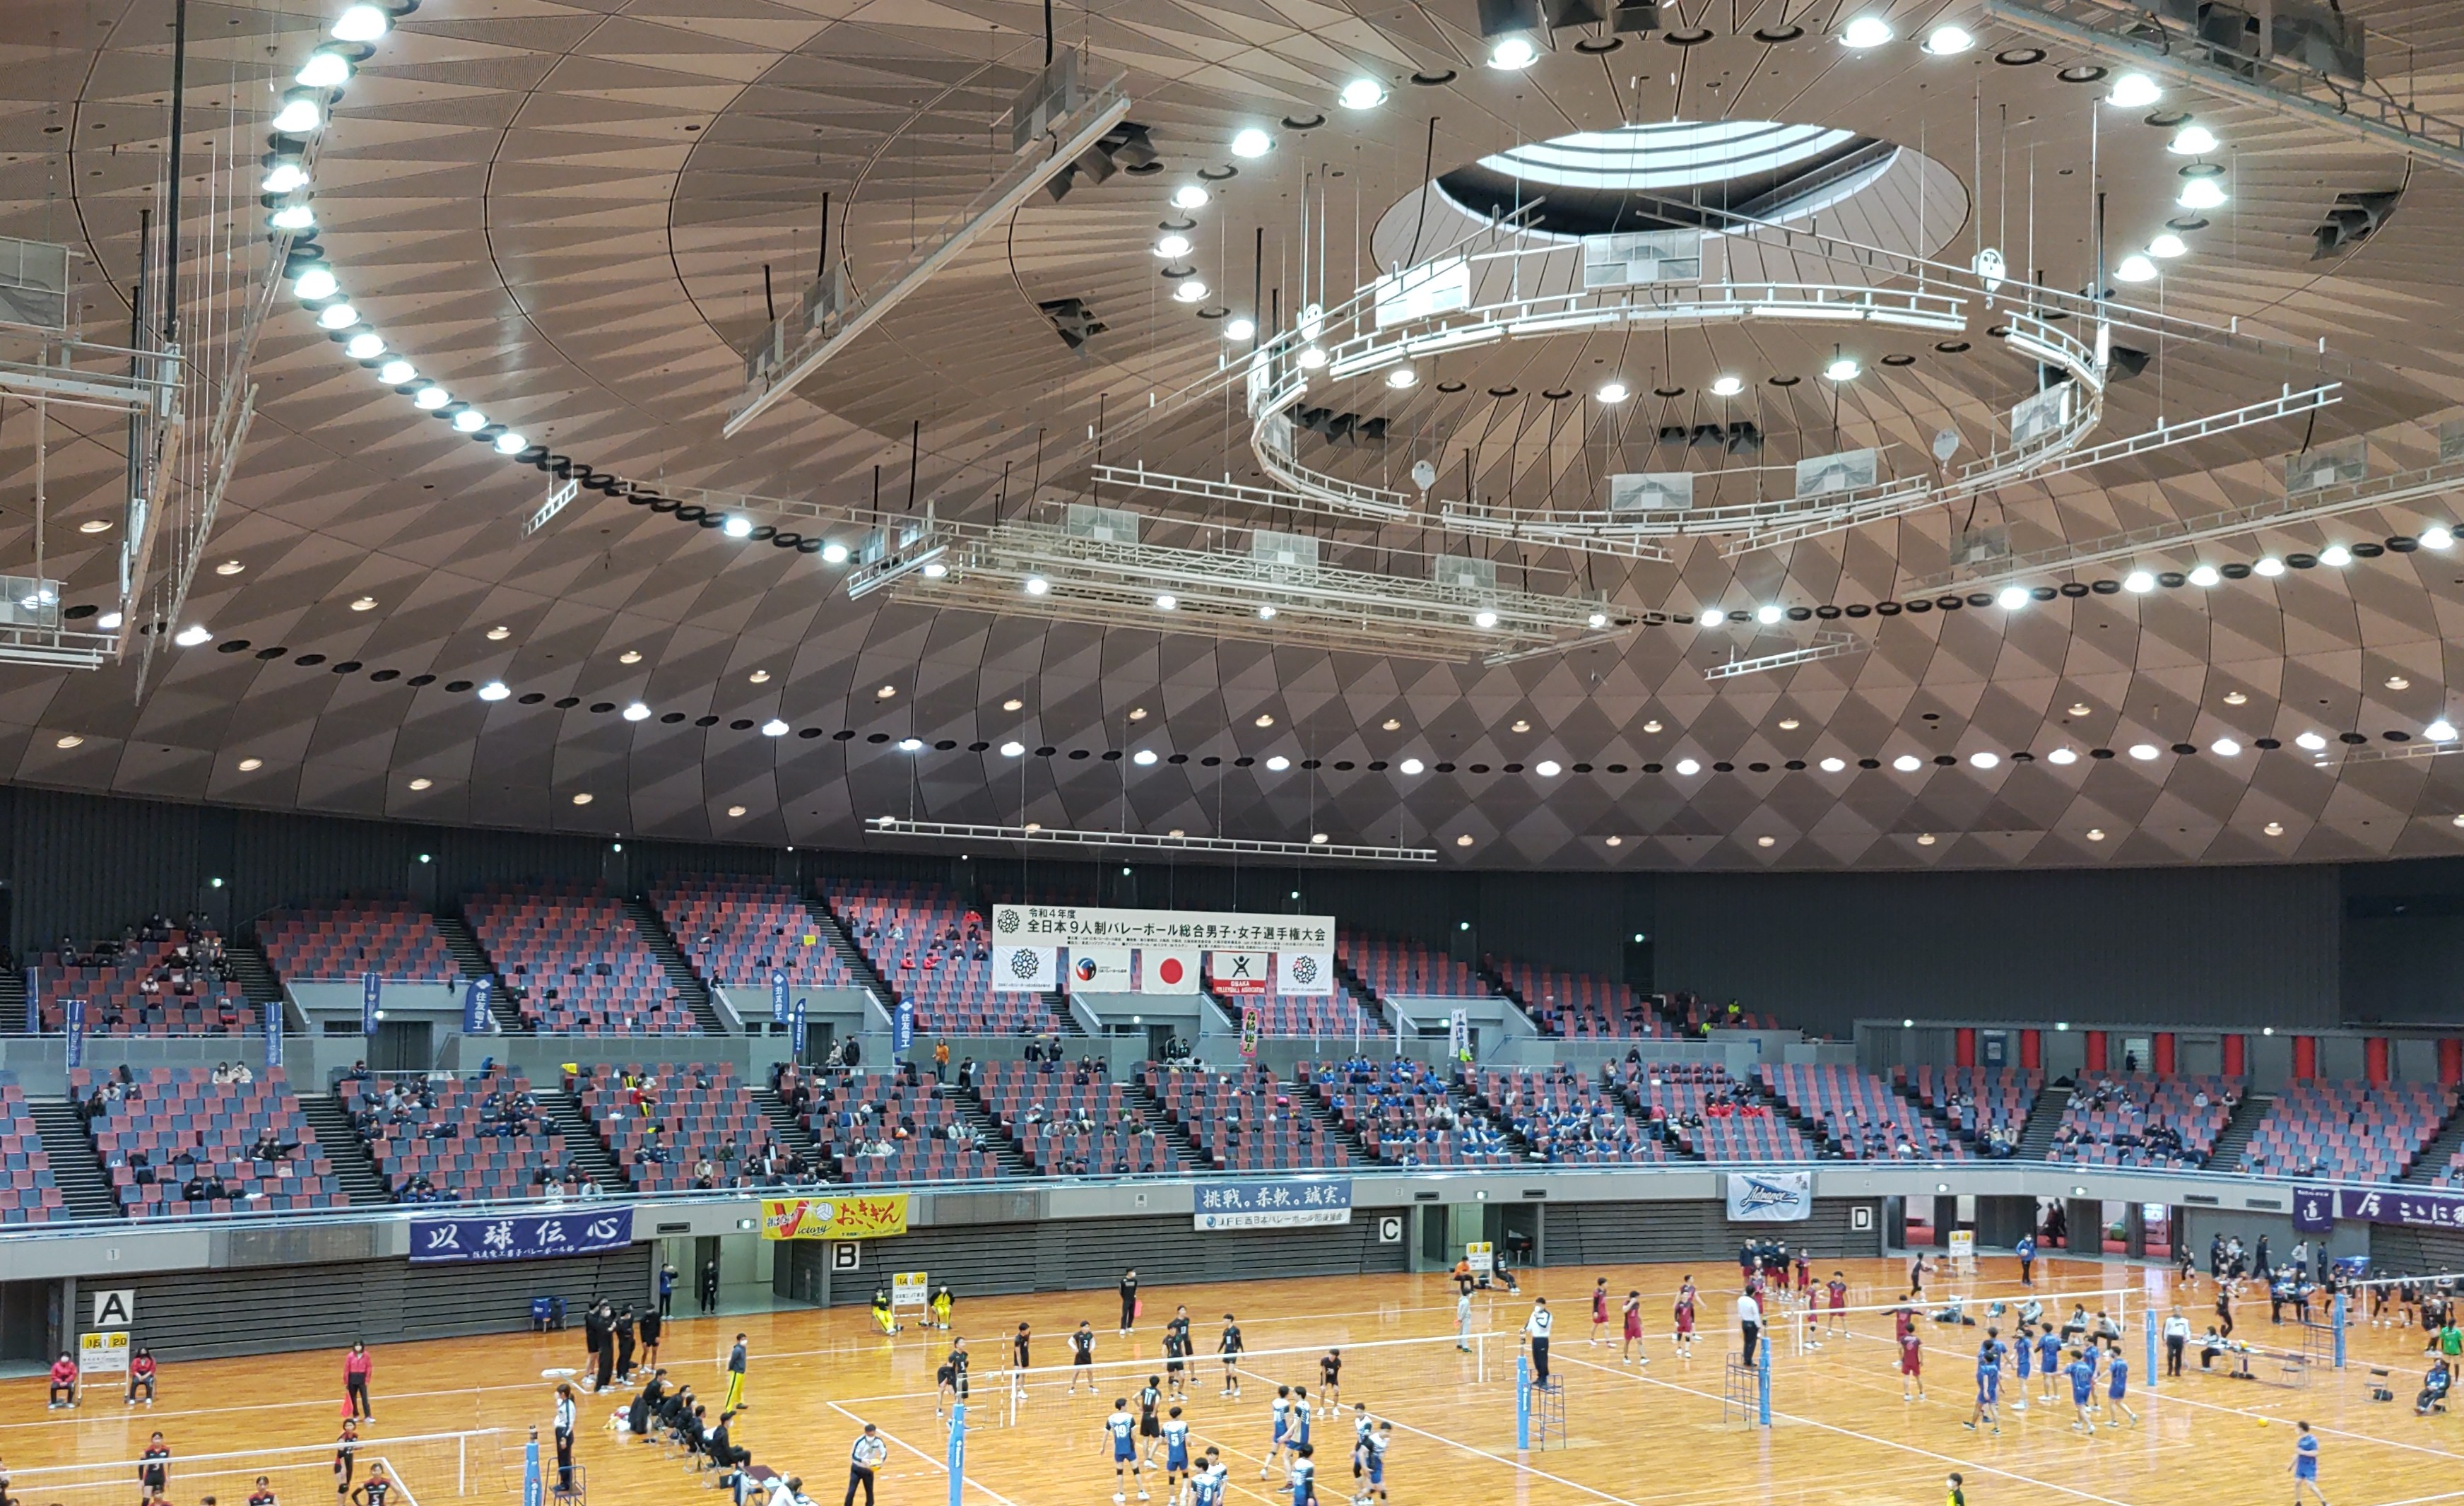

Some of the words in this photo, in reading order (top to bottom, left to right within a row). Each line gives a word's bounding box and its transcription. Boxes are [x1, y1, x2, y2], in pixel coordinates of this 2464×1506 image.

[1029, 908, 1076, 919] 令和4年度
[835, 1199, 901, 1230] おきぎん
[1855, 1208, 1869, 1228] D
[428, 1217, 618, 1250] 以球伝心
[1383, 1218, 1398, 1240] C
[836, 1244, 856, 1268] B
[98, 1293, 129, 1324] A
[1114, 1424, 1126, 1437] 19
[1171, 1433, 1179, 1447] 5
[1204, 1487, 1211, 1502] 9
